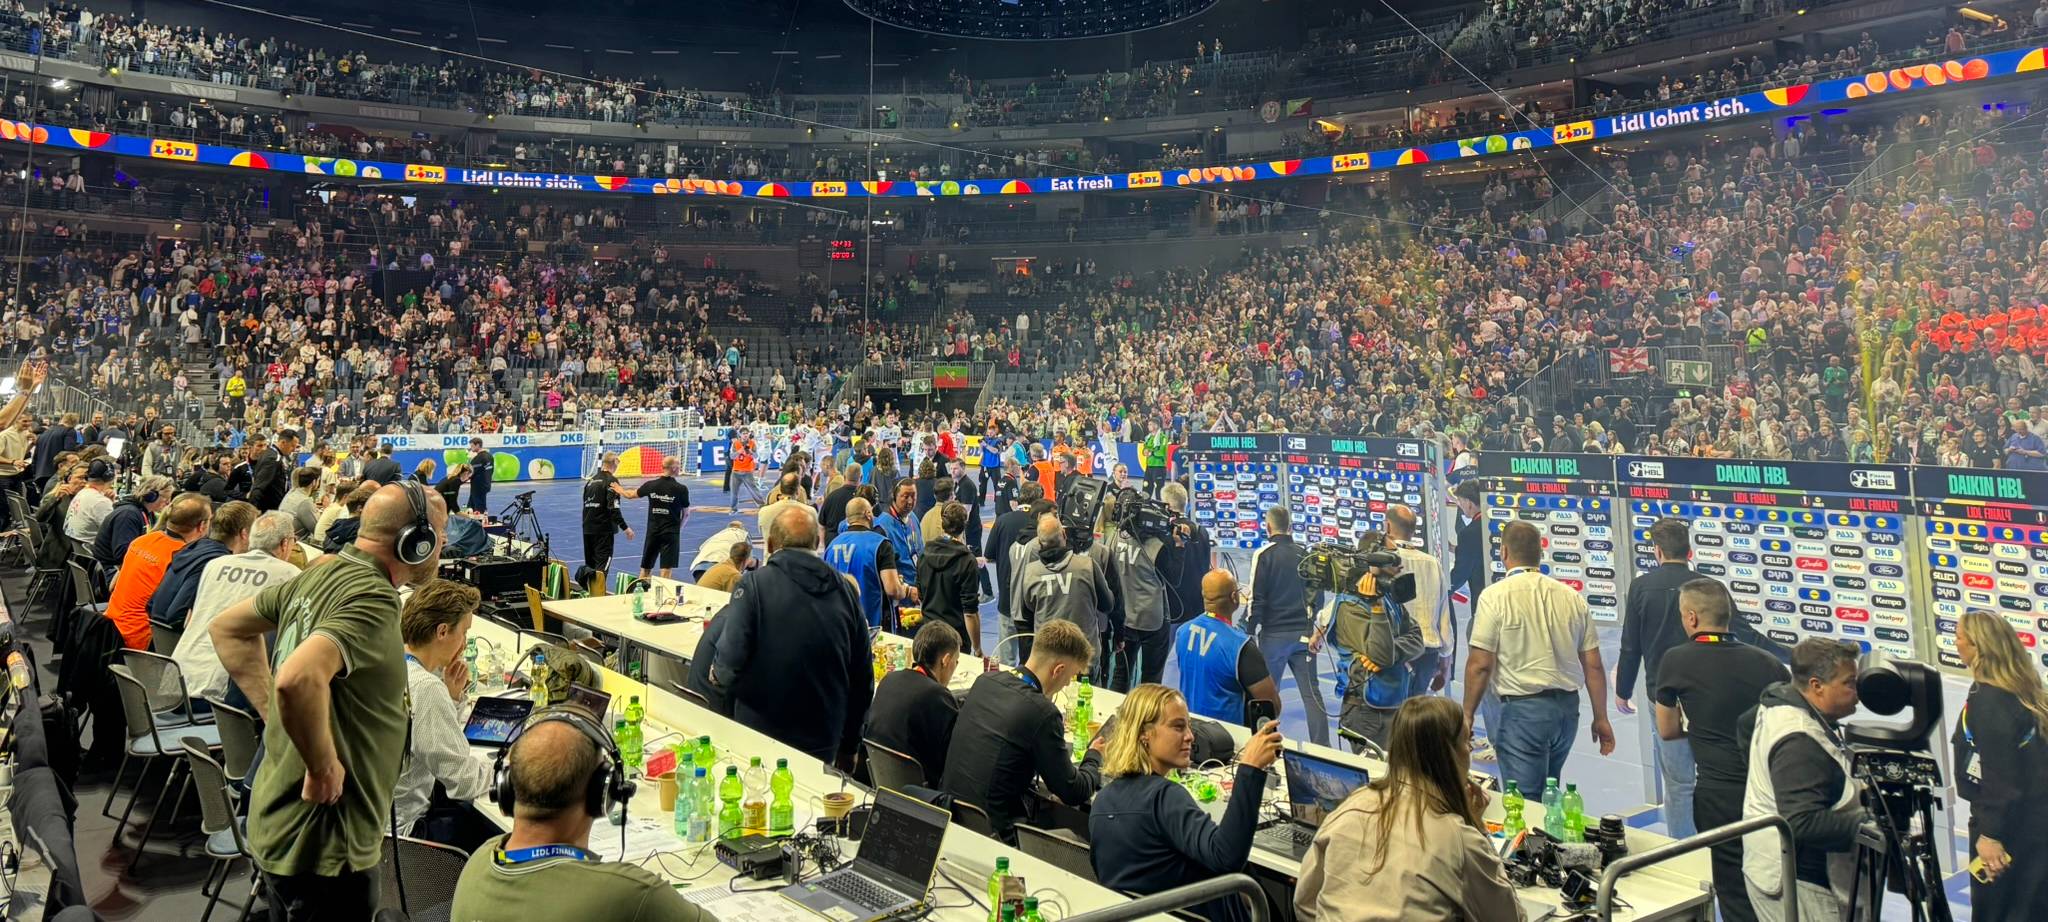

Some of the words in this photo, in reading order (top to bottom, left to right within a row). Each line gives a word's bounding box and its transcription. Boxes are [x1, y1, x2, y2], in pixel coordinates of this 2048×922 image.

[1612, 115, 1645, 134] Lidl
[1650, 107, 1699, 128] lohnt
[1704, 99, 1750, 119] sich.
[1557, 125, 1591, 140] LIDL
[155, 143, 193, 156] LIDL
[1335, 156, 1367, 168] LIDL
[408, 167, 442, 178] LIDL
[463, 171, 493, 185] Lidl
[498, 172, 541, 188] lohnt
[546, 175, 582, 189] sich.
[1051, 178, 1073, 190] Eat
[1077, 176, 1112, 189] fresh
[1130, 174, 1159, 185] LIDL
[815, 183, 844, 194] LIDL
[443, 436, 469, 446] DKB
[503, 435, 527, 446] DKB
[560, 433, 584, 443] DKB
[615, 431, 636, 440] DKB
[381, 436, 408, 447] DKB
[1211, 437, 1239, 448] DAIKIN
[1241, 437, 1257, 448] HBL
[1331, 439, 1353, 452] DAIKIN
[1354, 440, 1368, 454] HBL
[1510, 458, 1552, 475] DAIKIN
[1556, 459, 1580, 475] HBL
[1716, 464, 1761, 484] DAIKIN
[1763, 466, 1790, 485] HBL
[1526, 482, 1541, 492] LIDL
[1542, 483, 1568, 493] FINAL4
[1948, 474, 1995, 497] DAIKIN
[1997, 477, 2026, 499] HBL
[1630, 487, 1643, 497] LIDL
[1645, 487, 1669, 498] FINAL4
[1733, 492, 1748, 503] LIDL
[1750, 493, 1777, 504] FINAL4
[1849, 498, 1866, 510] LIDL
[1868, 499, 1898, 512] FINAL4
[1967, 506, 1982, 519] LIDL
[1984, 507, 2012, 521] FINAL4
[1554, 526, 1576, 534] Kempa
[1698, 535, 1720, 544] Kempa
[832, 543, 855, 563] TV
[1117, 541, 1141, 565] TV
[1834, 546, 1859, 556] Kempa
[1875, 548, 1894, 557] DKB
[1764, 556, 1789, 565] SELECT
[1589, 569, 1611, 577] Kempa
[1999, 562, 2024, 573] Kempa
[216, 566, 268, 586] FOTO
[1933, 571, 1956, 581] SELECT
[1041, 572, 1072, 596] TV
[1733, 583, 1756, 592] Kempa
[1770, 586, 1788, 594] DKB
[1875, 596, 1902, 607] Kempa
[1803, 605, 1828, 614] SELECT
[1939, 603, 1956, 612] DKB
[1187, 623, 1217, 656] TV
[1770, 632, 1794, 641] Kempa
[1941, 654, 1963, 665] Kemp
[531, 848, 550, 857] LIDL
